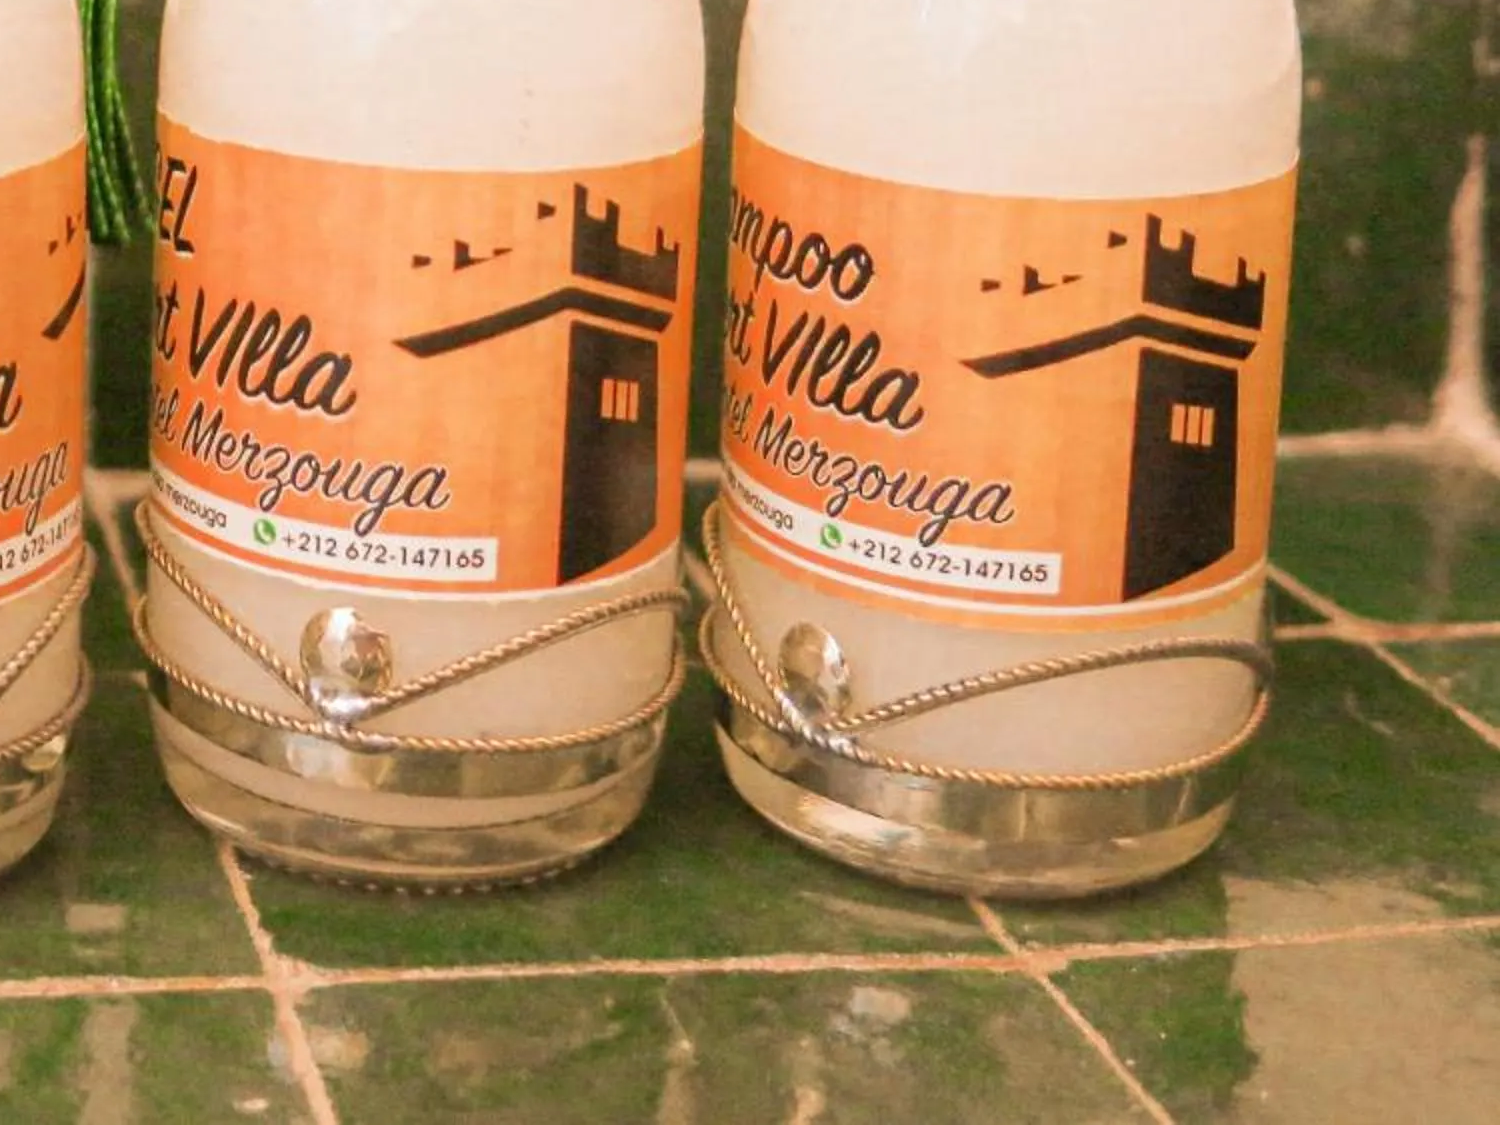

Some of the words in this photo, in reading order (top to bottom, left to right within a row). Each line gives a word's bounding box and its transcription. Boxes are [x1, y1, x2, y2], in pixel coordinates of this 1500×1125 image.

[180, 398, 450, 535] Merzouga
[753, 408, 1014, 546] Merzouga
[165, 482, 228, 528] merzouga
[737, 480, 794, 531] merzouga
[282, 531, 338, 558] +212
[345, 541, 485, 570] 672-147165
[848, 538, 902, 566] +212
[909, 551, 1049, 583] 672-147165
